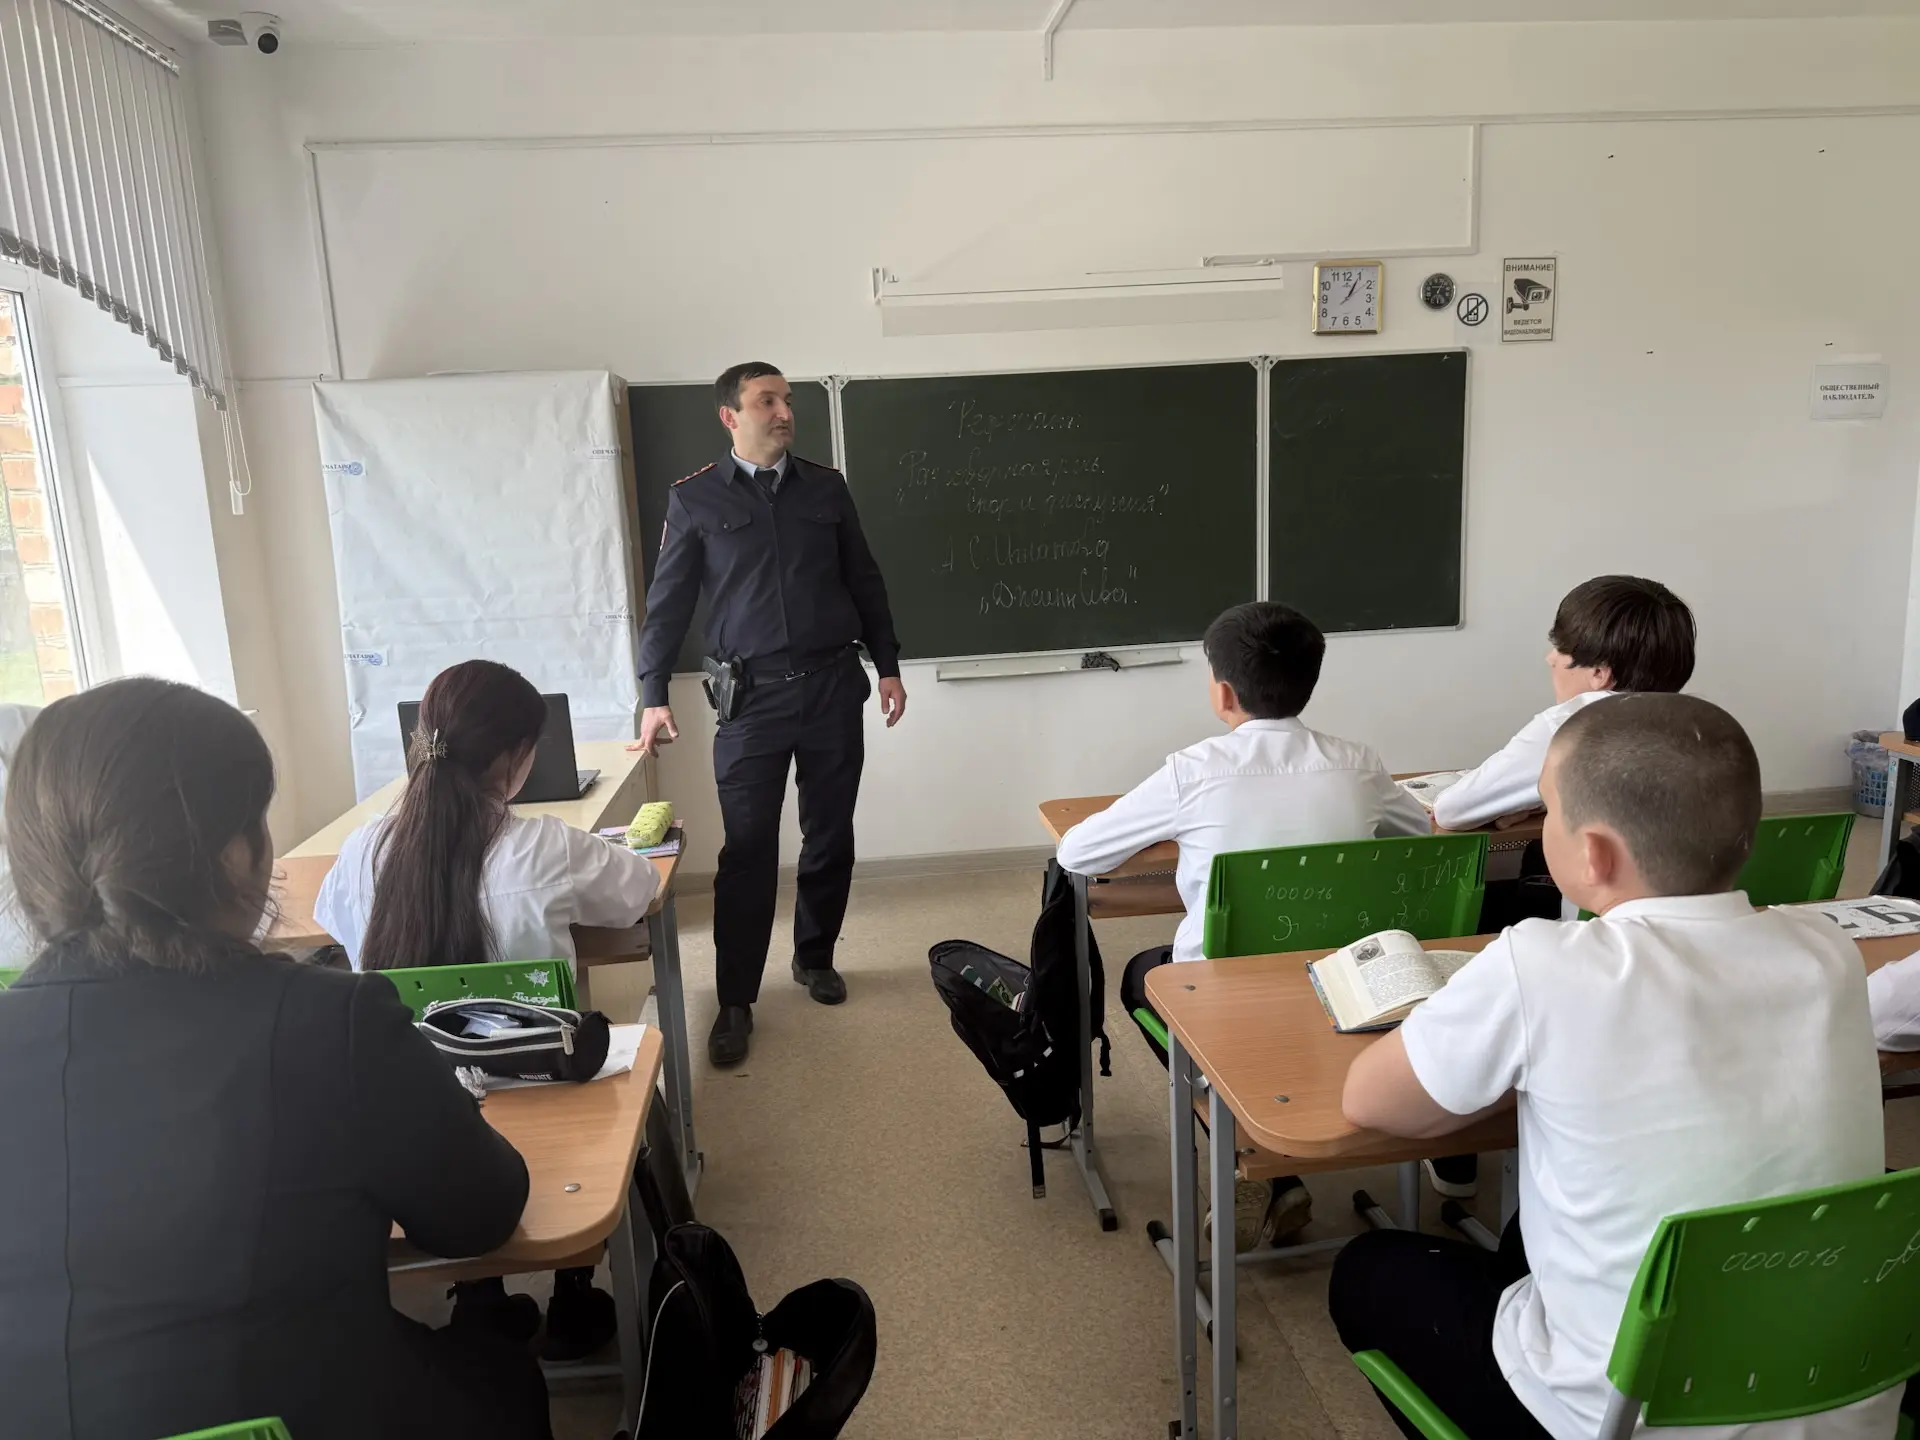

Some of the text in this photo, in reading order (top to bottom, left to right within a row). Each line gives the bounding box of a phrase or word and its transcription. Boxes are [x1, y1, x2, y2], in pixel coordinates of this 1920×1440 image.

[1332, 272, 1339, 281] 11
[1342, 272, 1352, 281] 12
[1357, 272, 1362, 280] 1
[1321, 281, 1331, 291] 10
[1366, 280, 1373, 289] 2
[1322, 295, 1328, 304] 9
[1366, 294, 1372, 303] 3
[1321, 308, 1328, 318] 8
[1365, 307, 1371, 316] 4
[1331, 316, 1337, 326] 7
[1343, 316, 1349, 326] 6
[1354, 316, 1361, 325] 5
[1820, 383, 1880, 391] ОБЩЕСТВЕННЫЙ
[519, 1073, 553, 1082] PRIVATE
